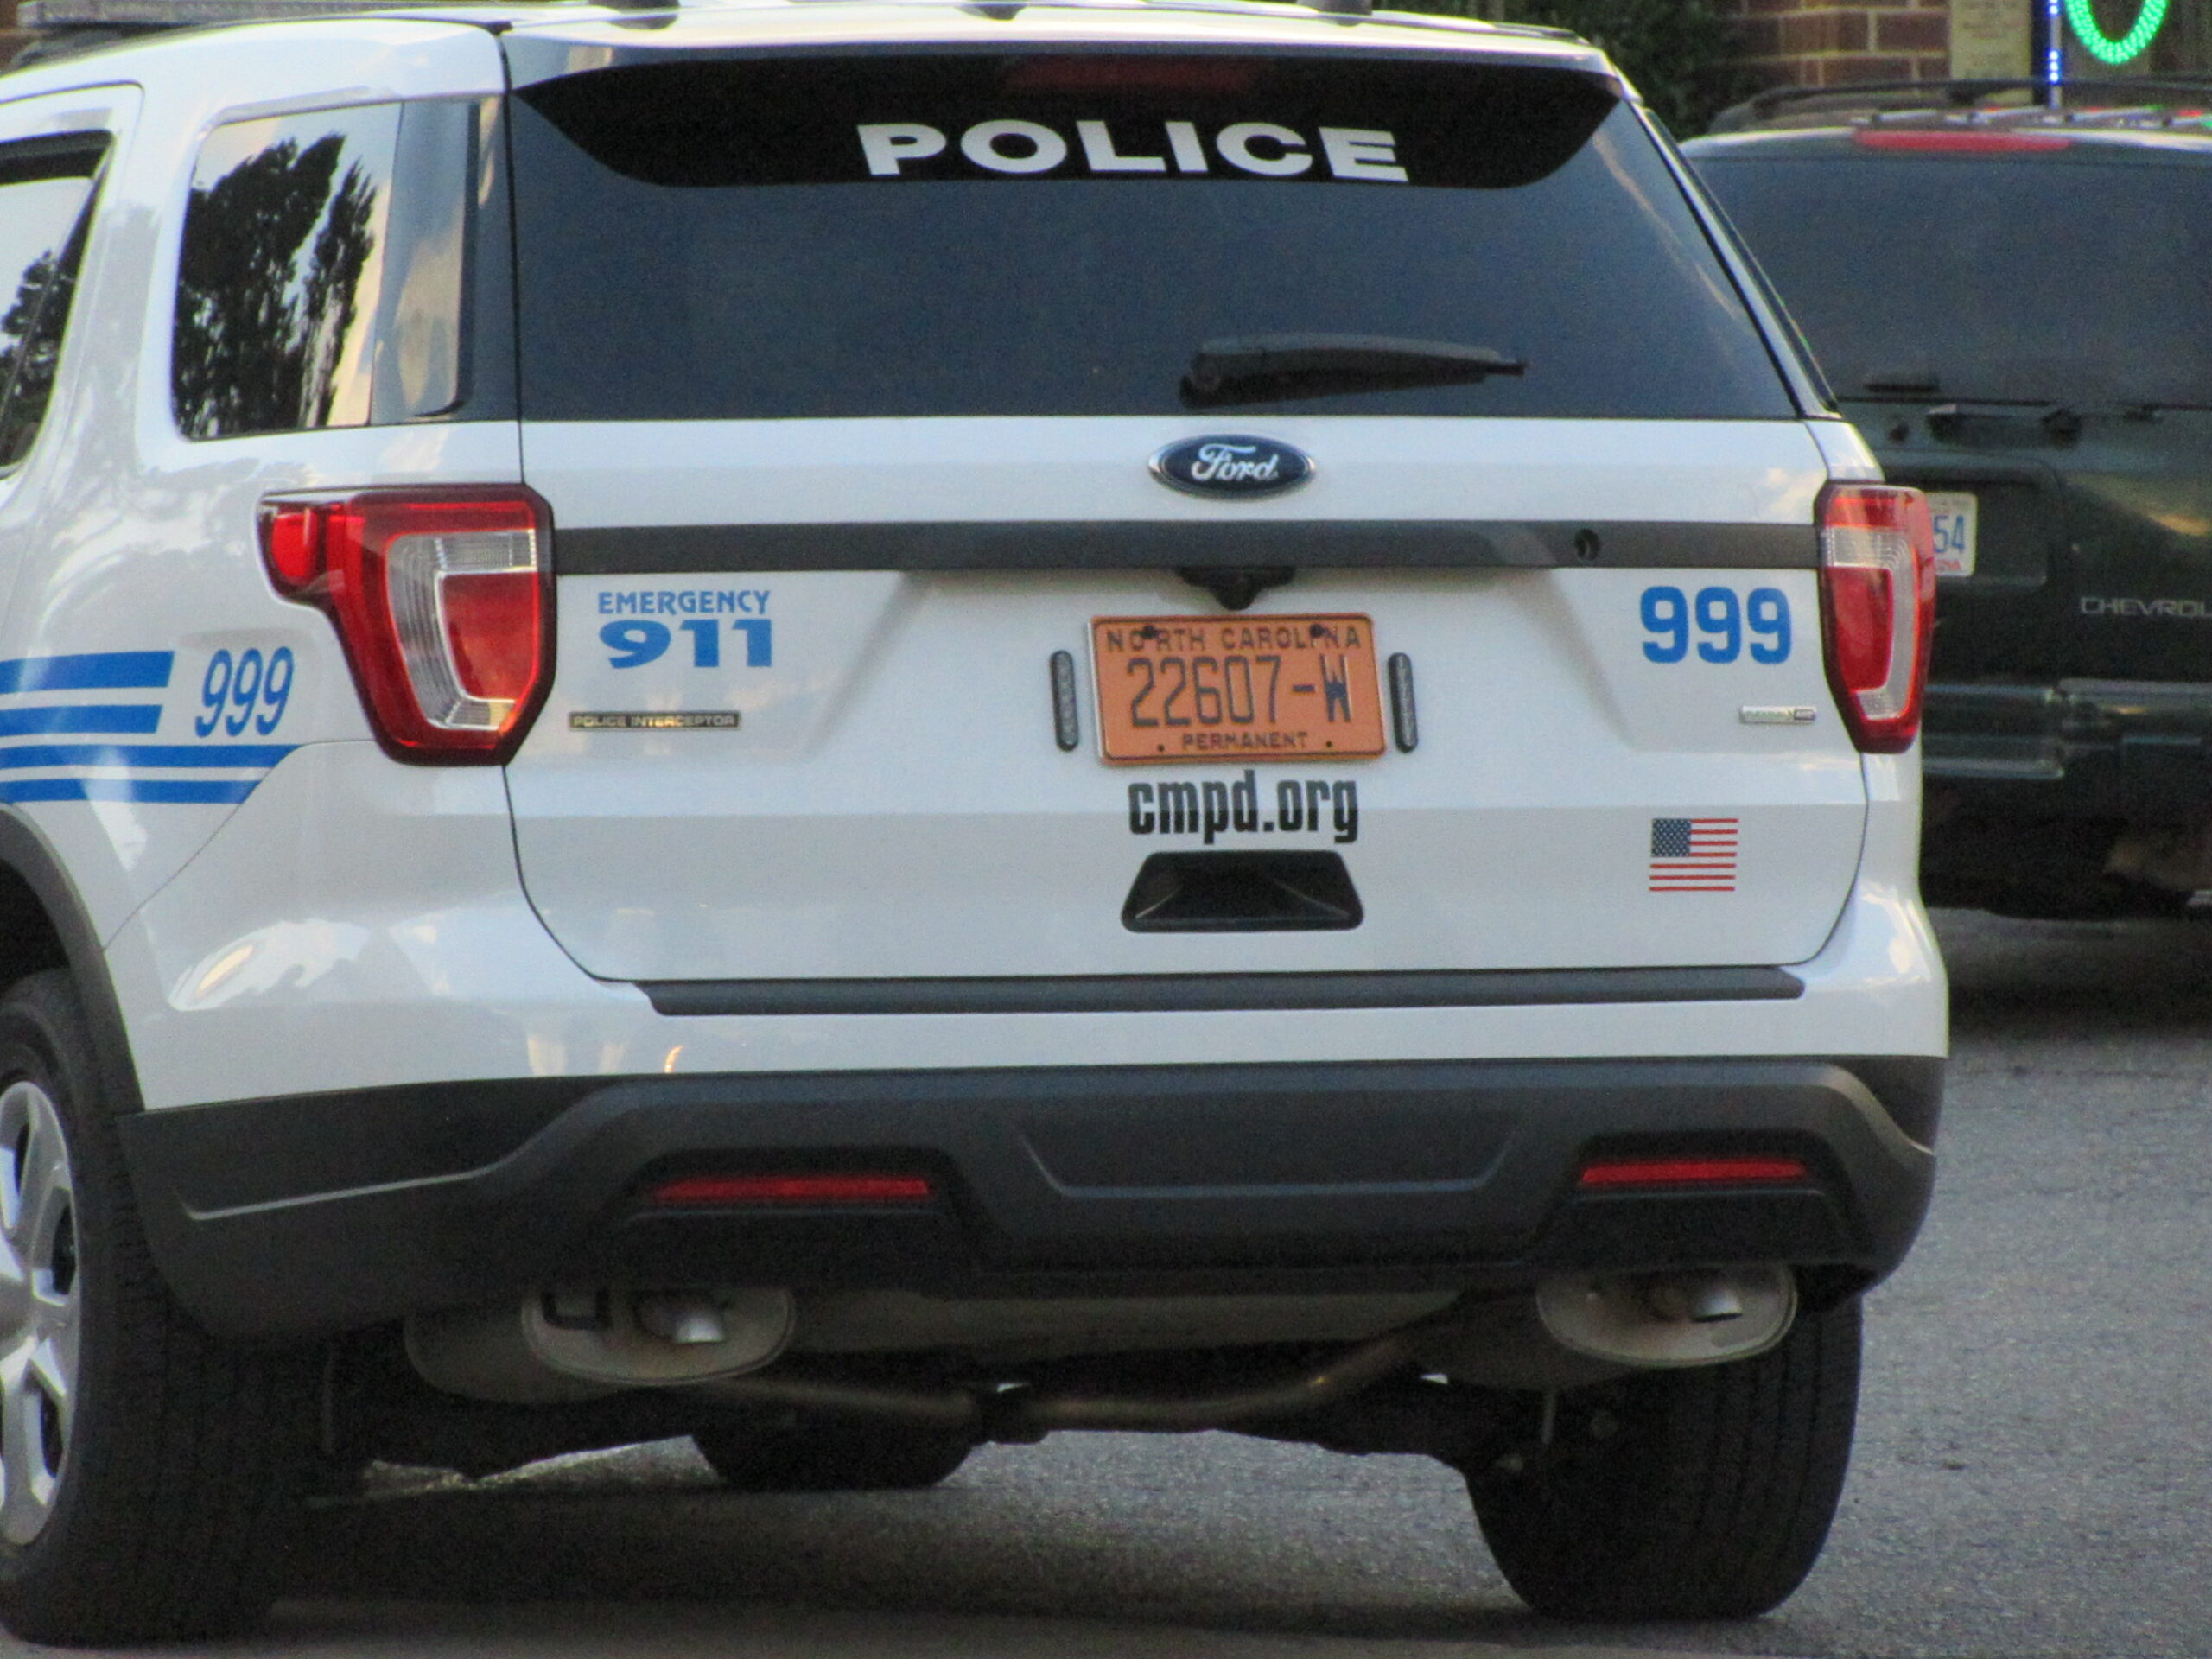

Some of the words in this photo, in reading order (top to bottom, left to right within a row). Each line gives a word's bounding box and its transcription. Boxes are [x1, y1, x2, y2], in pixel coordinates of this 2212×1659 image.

[856, 119, 1410, 183] POLICE
[1190, 443, 1280, 481] Ford
[597, 590, 772, 614] EMERGENCY
[1640, 585, 1792, 665] 999
[599, 618, 772, 669] 911
[1107, 628, 1206, 652] NORTH
[194, 646, 295, 738] 999
[1127, 654, 1352, 728] 22607-W
[573, 715, 627, 728] POLICE
[631, 715, 734, 727] INTERCEPTOR
[1182, 731, 1308, 750] PERMANENT
[1128, 770, 1359, 844] cmpd.org
